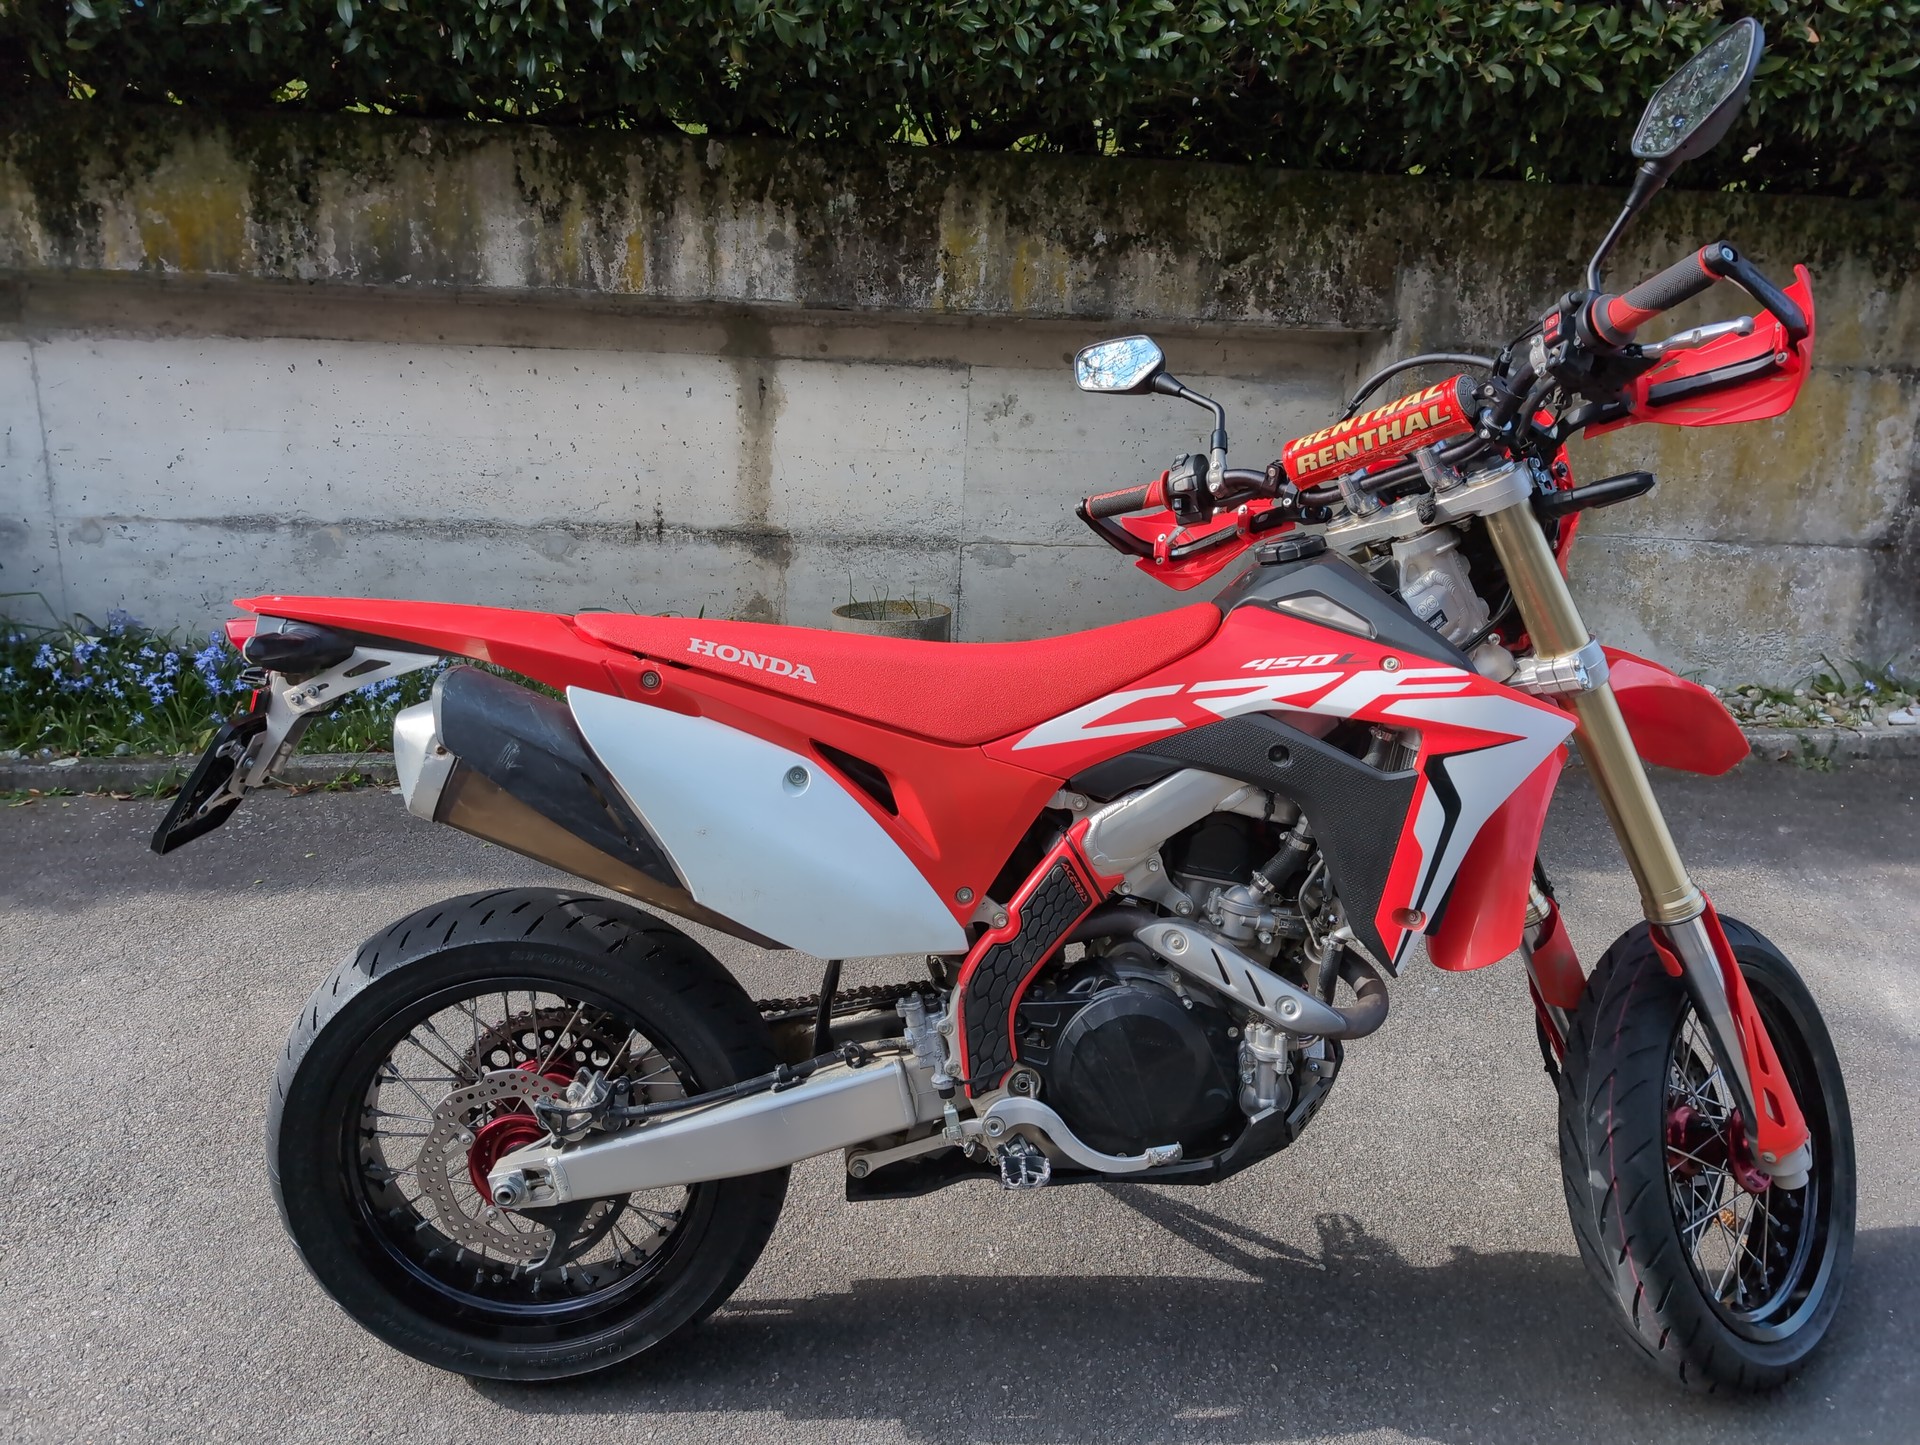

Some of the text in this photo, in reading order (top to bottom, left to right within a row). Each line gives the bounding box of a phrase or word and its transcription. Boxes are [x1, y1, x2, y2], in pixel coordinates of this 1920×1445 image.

[1291, 383, 1445, 452] RENTHAL
[1296, 405, 1451, 475] RENTHAL
[687, 637, 817, 684] HONDA
[1011, 668, 1471, 751] CRF
